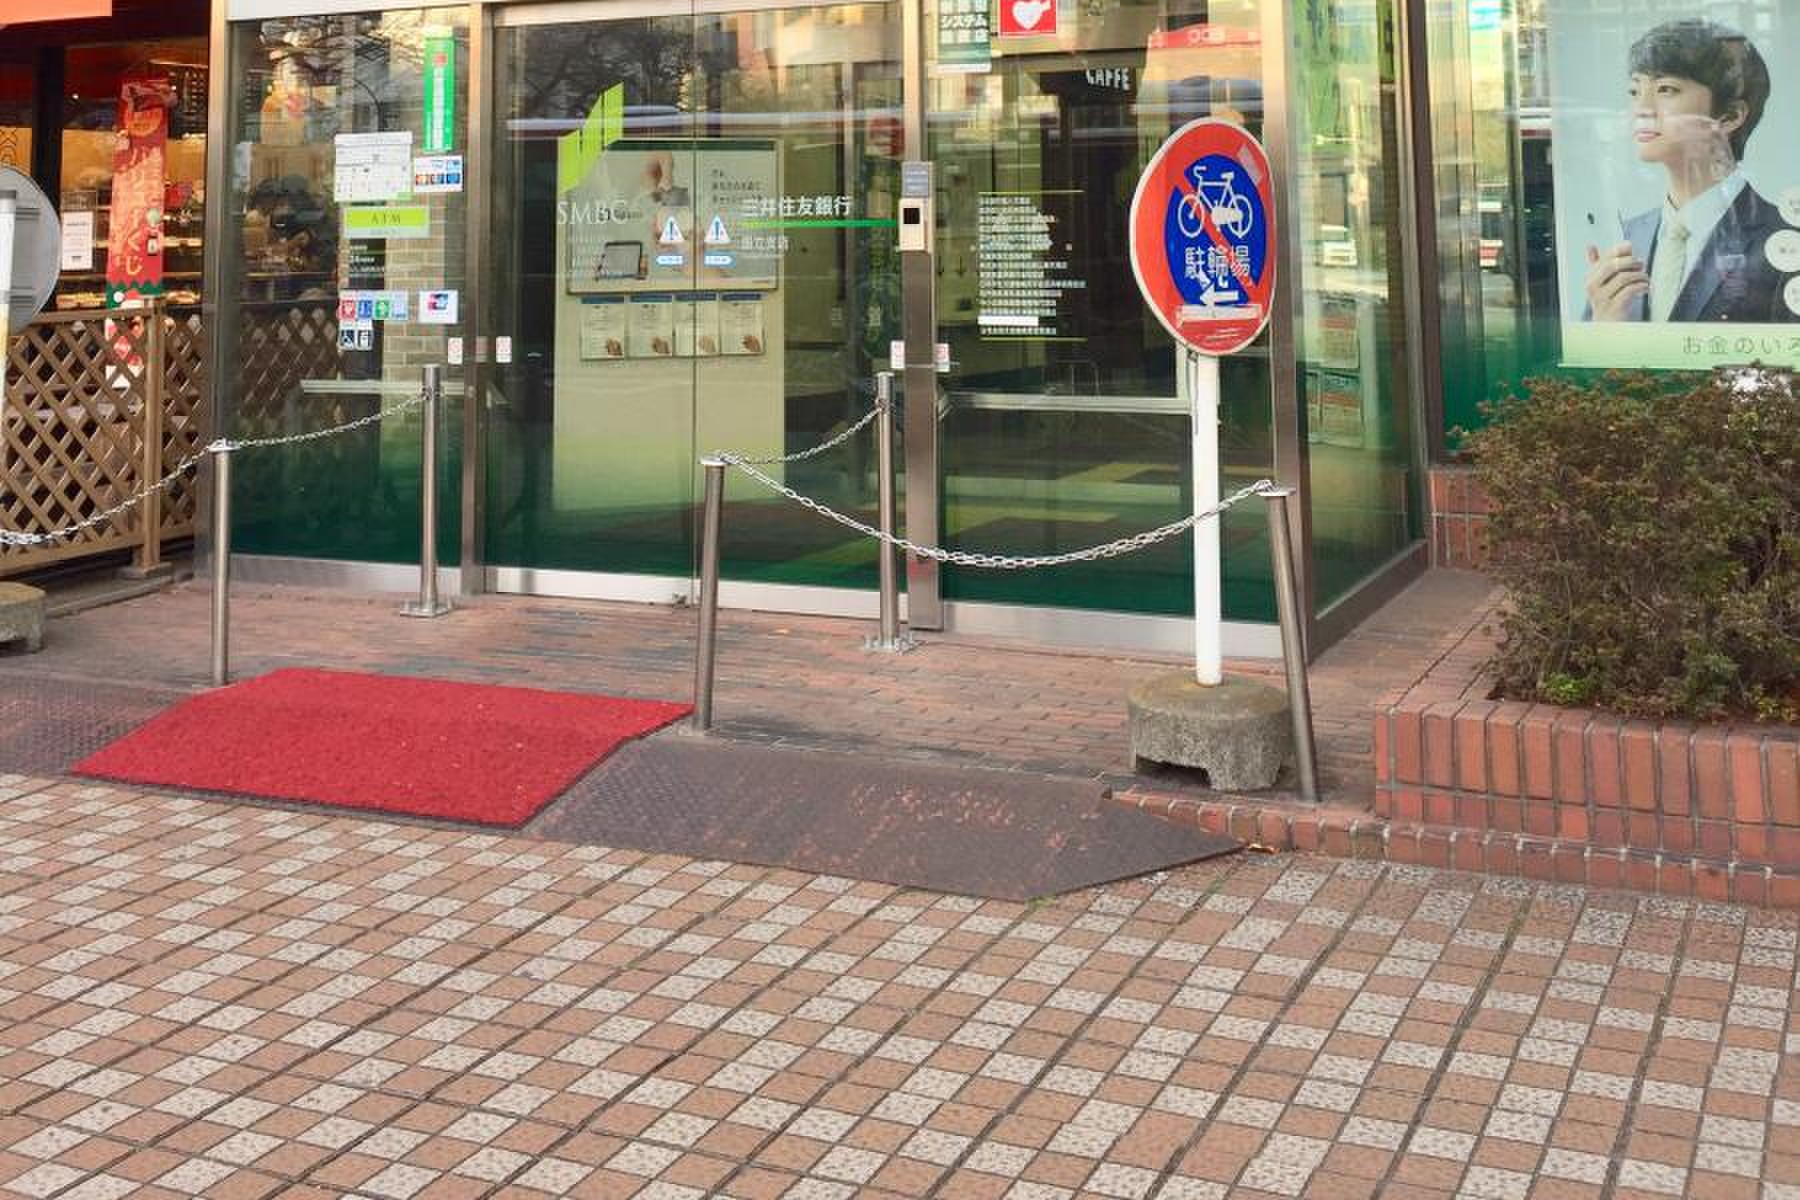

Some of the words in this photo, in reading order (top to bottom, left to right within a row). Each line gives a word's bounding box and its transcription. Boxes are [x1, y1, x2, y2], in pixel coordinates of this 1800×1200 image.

[557, 200, 627, 226] SMBC
[741, 195, 851, 217] 三井住友銀行
[370, 212, 400, 225] ATM
